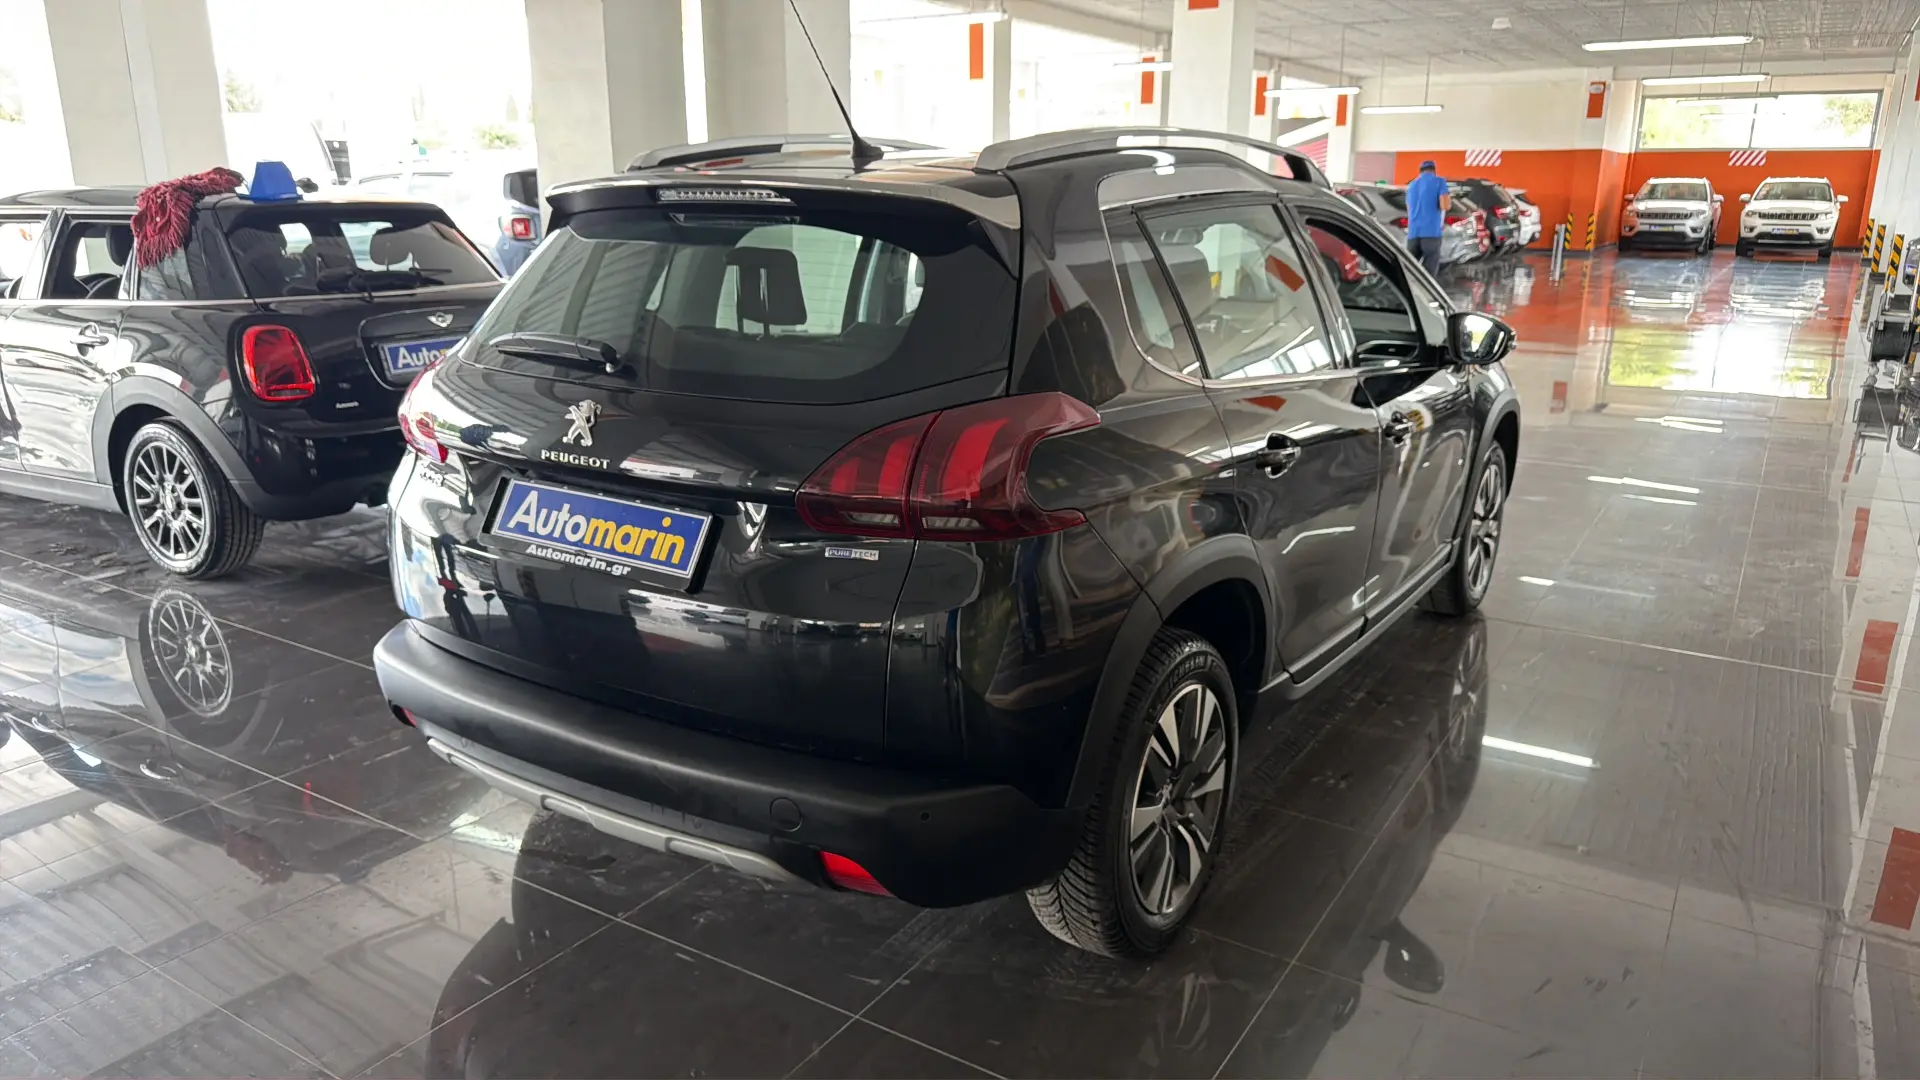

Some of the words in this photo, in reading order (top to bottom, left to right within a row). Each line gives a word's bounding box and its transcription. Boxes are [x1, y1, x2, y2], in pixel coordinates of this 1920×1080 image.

[541, 449, 610, 469] PEUGEOT
[507, 490, 685, 564] Automarin
[526, 544, 631, 576] Automarin.gr
